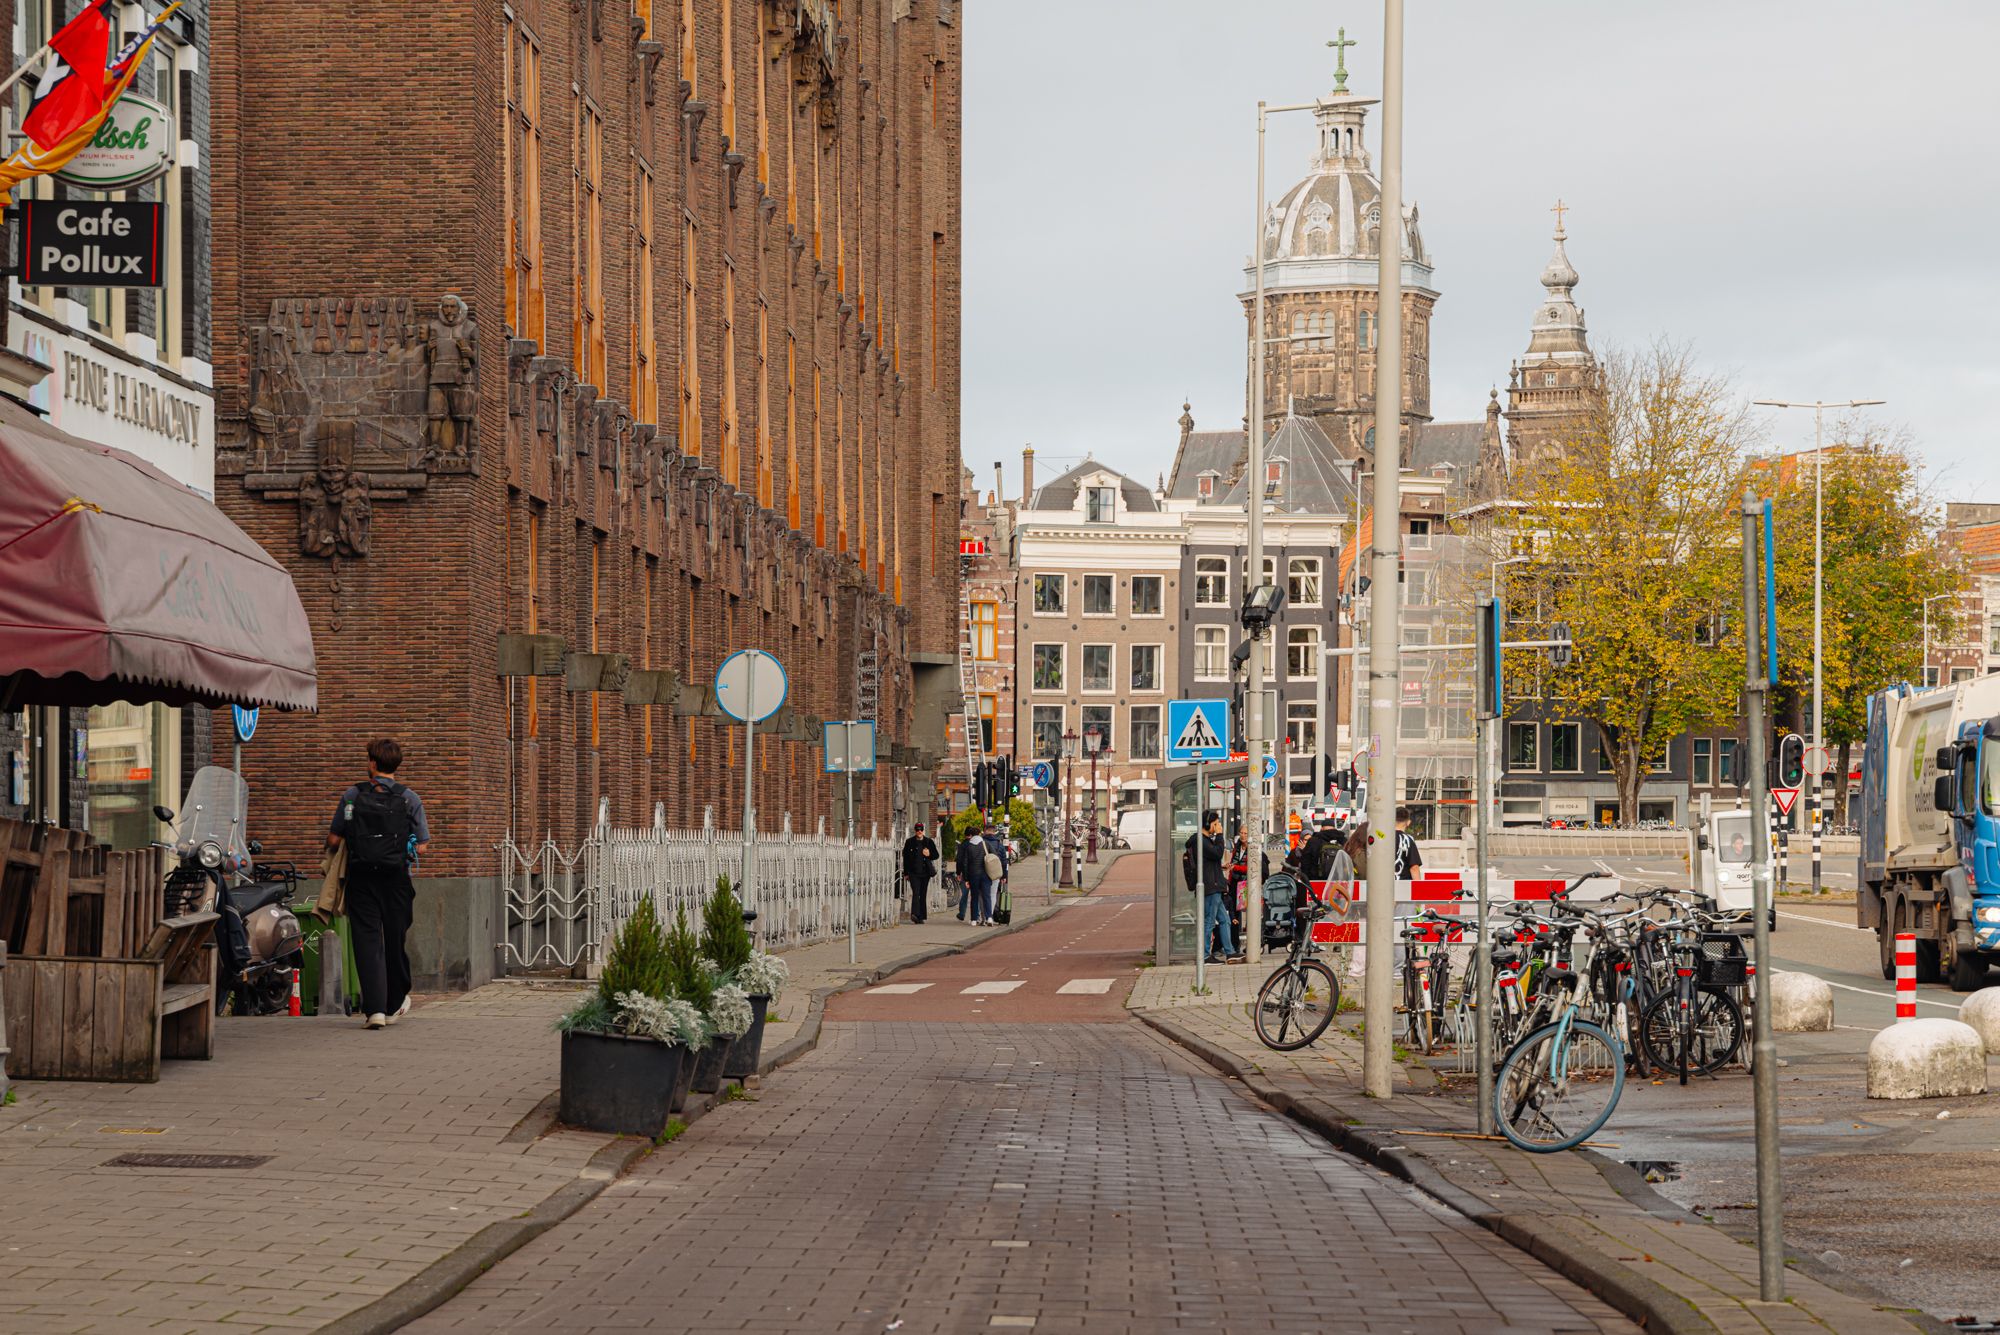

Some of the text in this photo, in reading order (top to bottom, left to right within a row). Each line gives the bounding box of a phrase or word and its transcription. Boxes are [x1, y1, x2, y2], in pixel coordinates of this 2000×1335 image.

[86, 115, 154, 149] lsch
[56, 207, 131, 237] Cafe
[40, 244, 144, 275] Pollux
[63, 350, 202, 448] FINE HARMONY
